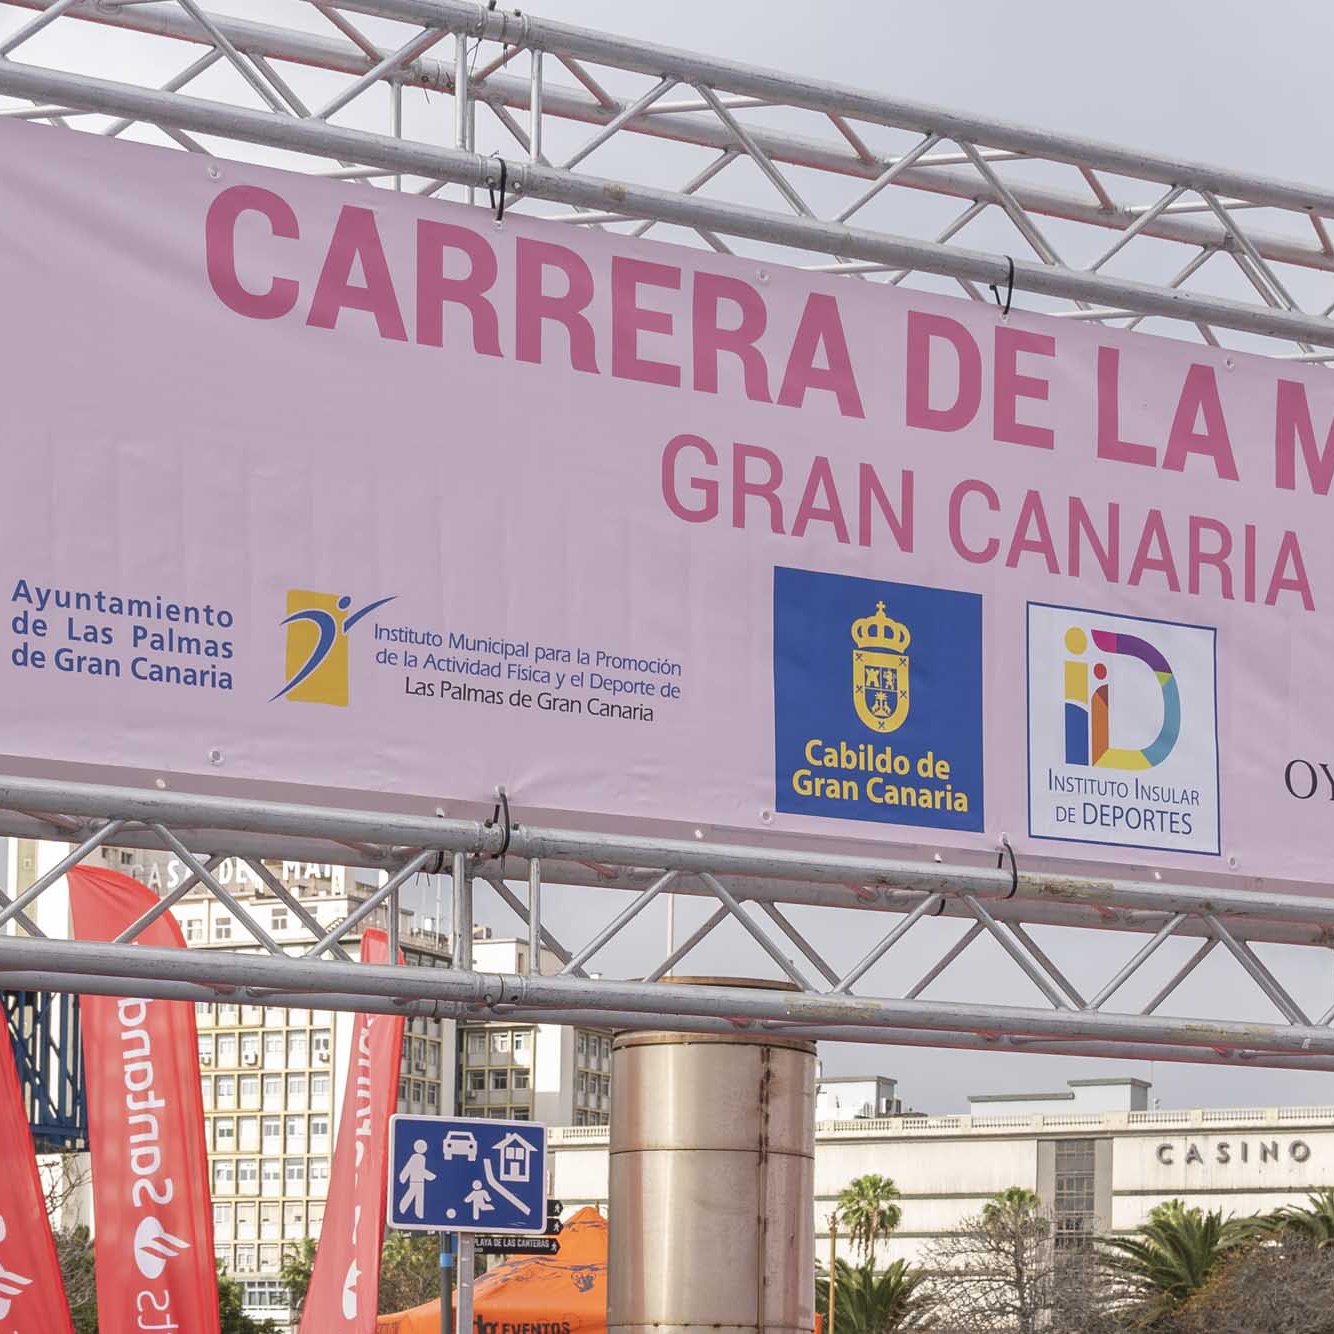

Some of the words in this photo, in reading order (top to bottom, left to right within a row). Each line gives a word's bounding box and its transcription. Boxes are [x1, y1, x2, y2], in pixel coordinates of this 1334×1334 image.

[205, 185, 865, 419] CARRERA
[907, 311, 1055, 450] DE
[1097, 346, 1239, 481] LA
[662, 434, 913, 552] GRAN
[949, 480, 1315, 611] CANARIA
[12, 580, 233, 627] Ayuntamiento
[12, 611, 47, 637] de
[68, 618, 113, 644] Las
[133, 625, 233, 658] Palmas
[374, 624, 442, 646] Instituto
[449, 633, 528, 659] Municipal
[535, 647, 570, 663] para
[577, 648, 590, 665] la
[597, 651, 681, 676] Promoción
[12, 642, 46, 668] de
[54, 648, 120, 677] Gran
[131, 657, 233, 689] Canaria
[376, 649, 397, 666] de
[404, 651, 417, 667] la
[423, 654, 500, 676] Actividad
[508, 662, 550, 683] Física
[555, 672, 565, 689] y
[571, 671, 583, 687] el
[590, 673, 654, 694] Deporte
[660, 682, 680, 698] de
[405, 676, 434, 695] Las
[441, 681, 503, 704] Palmas
[509, 690, 532, 707] de
[538, 692, 581, 713] Gran
[588, 698, 653, 721] Canaria
[805, 739, 910, 776] Cabildo
[917, 751, 950, 780] de
[792, 770, 859, 800] Gran
[867, 777, 969, 812] Canaria
[1048, 768, 1128, 798] INSTITUTO
[1135, 774, 1199, 806] INSULAR
[1056, 806, 1076, 823] DE
[1083, 802, 1192, 835] DEPORTES
[1156, 1140, 1311, 1166] CASINO
[494, 1239, 501, 1247] DE
[503, 1239, 516, 1247] LAS
[518, 1239, 549, 1248] CANTERAS
